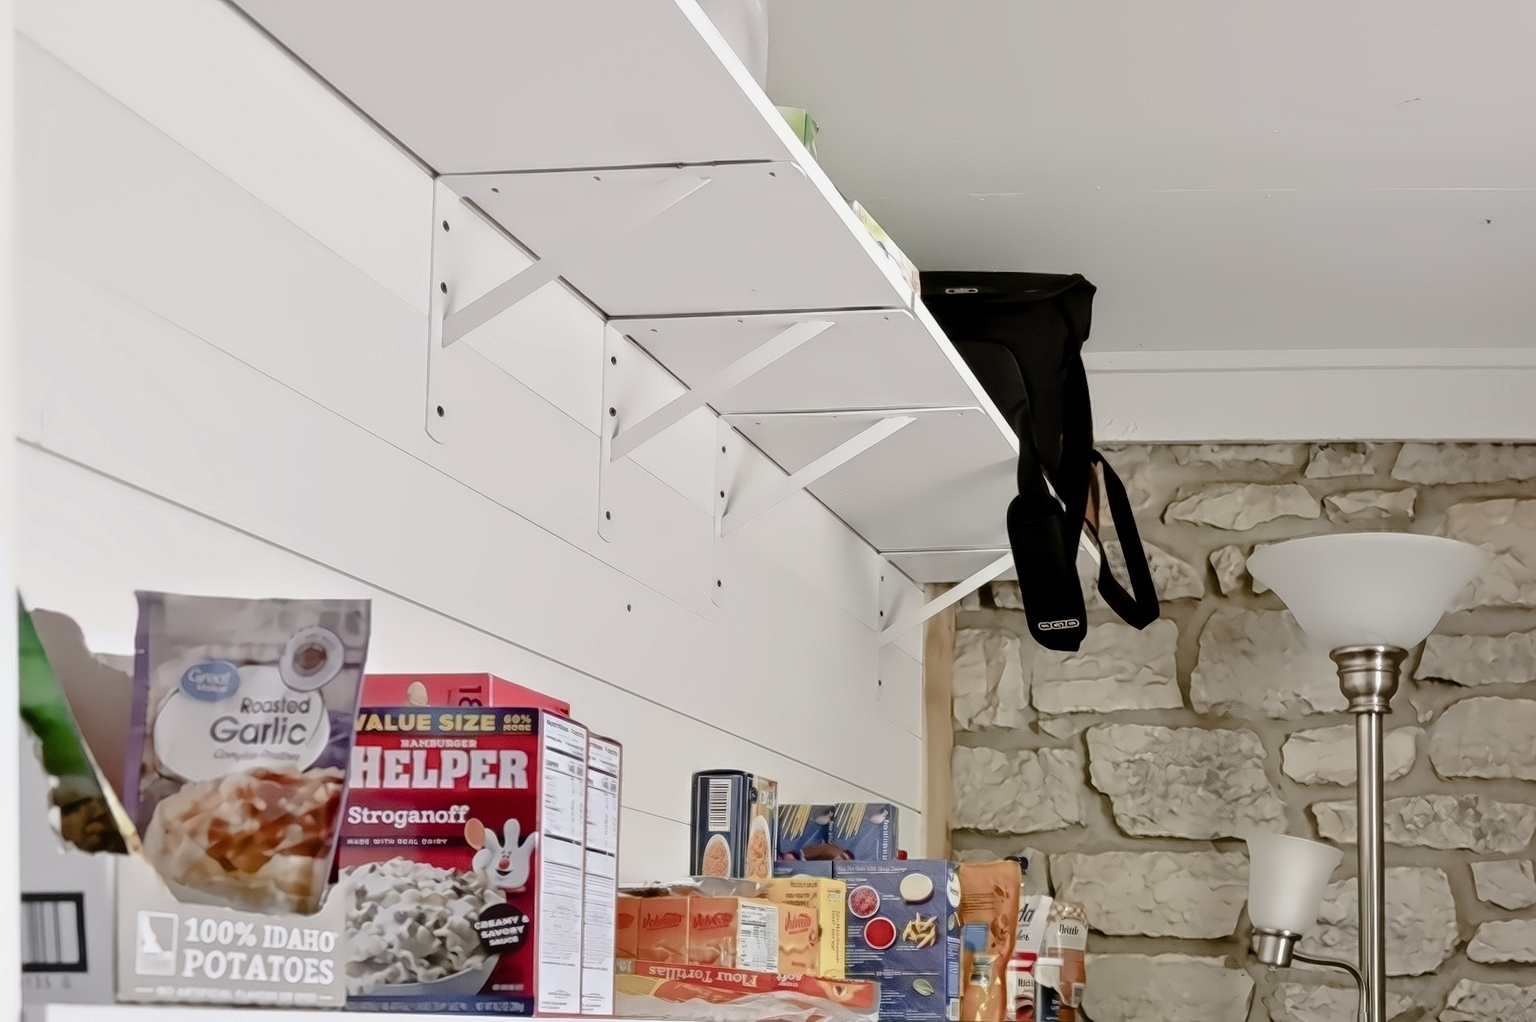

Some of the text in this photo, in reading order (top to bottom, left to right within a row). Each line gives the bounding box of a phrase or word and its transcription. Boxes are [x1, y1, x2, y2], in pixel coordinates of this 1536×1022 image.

[240, 697, 311, 714] Roasted
[210, 715, 307, 746] Garlic
[355, 714, 496, 732] VALUE SIZE
[348, 745, 529, 789] HELPER
[347, 805, 470, 829] Stroganoff
[184, 916, 336, 953] 100% IDAHO
[181, 948, 335, 986] POTATOES
[648, 964, 759, 988] Flour Tortillas
